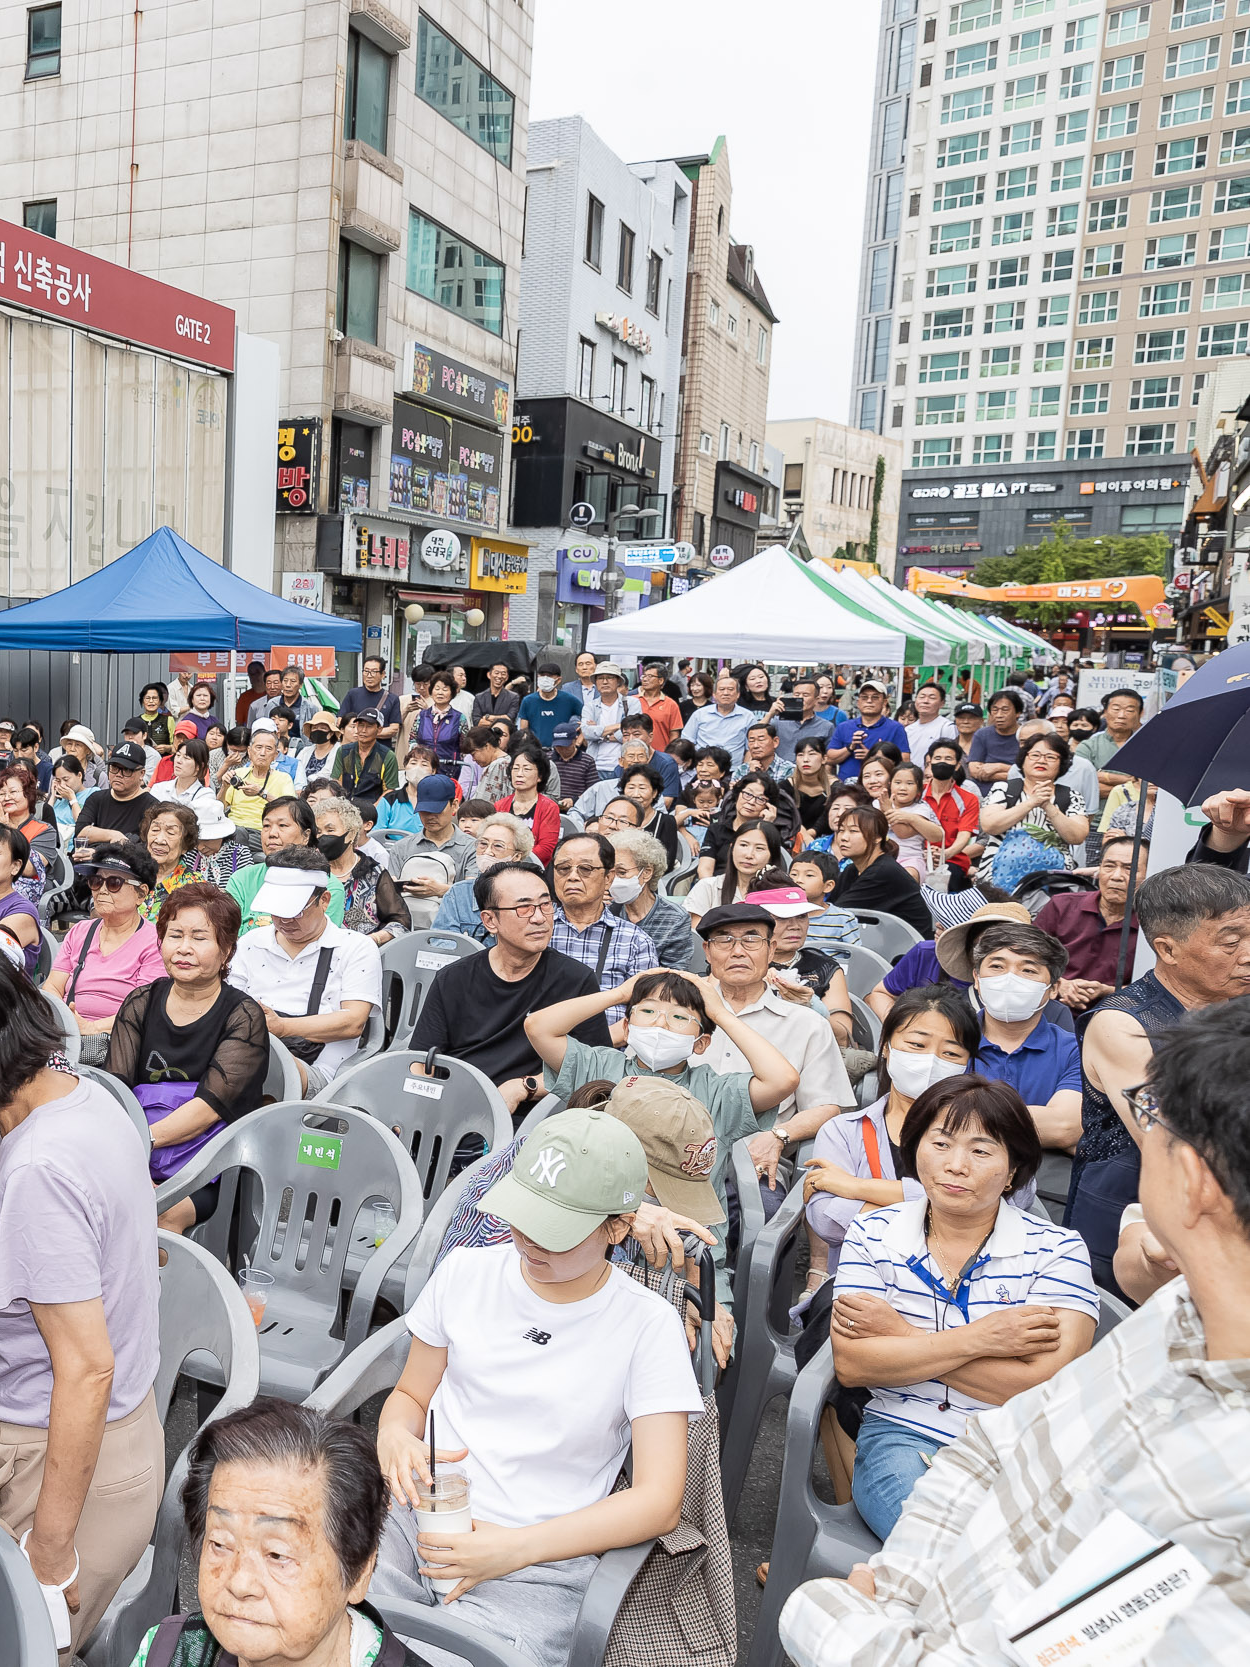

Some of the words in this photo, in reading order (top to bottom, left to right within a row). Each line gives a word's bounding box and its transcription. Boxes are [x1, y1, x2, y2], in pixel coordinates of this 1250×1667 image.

[13, 253, 92, 313] 신축공사
[175, 314, 203, 343] GATE
[203, 325, 212, 346] 2
[1010, 482, 1029, 495] PT
[431, 536, 445, 546] 대전
[425, 545, 447, 558] 순대국
[573, 549, 592, 558] CU
[1057, 585, 1103, 598] 미가로
[1091, 675, 1127, 683] MUSIC
[1087, 682, 1130, 690] STUDIO
[302, 1144, 336, 1161] 내빈석
